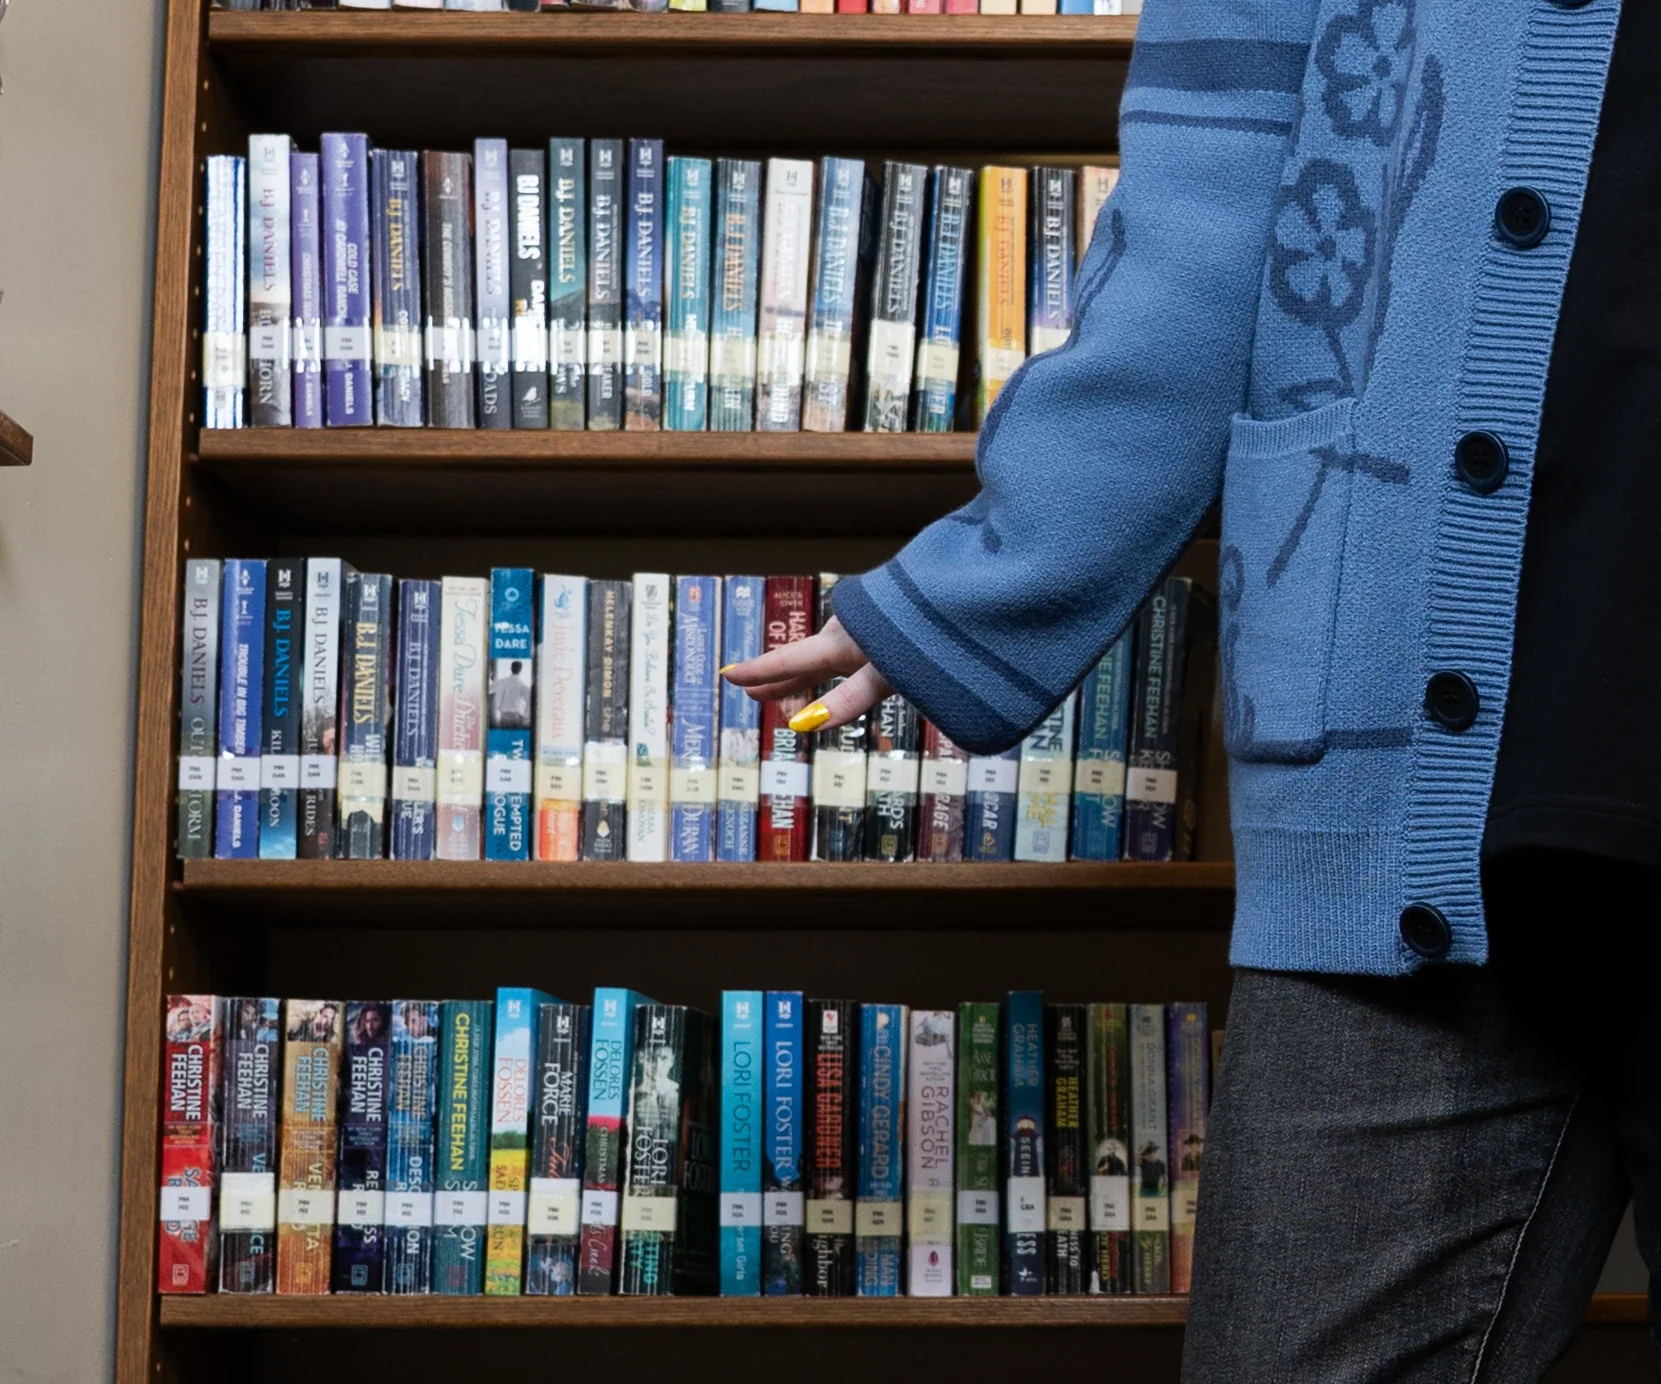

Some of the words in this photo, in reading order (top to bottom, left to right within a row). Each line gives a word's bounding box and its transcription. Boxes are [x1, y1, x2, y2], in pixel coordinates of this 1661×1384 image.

[347, 242, 358, 268] COLD
[348, 271, 358, 293] CASE
[637, 221, 652, 297] DANIELS
[1047, 243, 1062, 319] DANIELS
[453, 598, 478, 645] Tessa
[552, 623, 574, 662] Jude
[604, 591, 615, 653] HELENKAY
[1147, 596, 1166, 674] CHRISTINE
[189, 627, 207, 704] DANIELS
[237, 643, 249, 685] TROUBLE
[237, 687, 248, 697] IN
[313, 633, 328, 704] DANIELS
[453, 652, 477, 693] Dare
[602, 658, 613, 698] DIMON
[236, 698, 247, 716] BIG
[552, 666, 572, 740] Deveraux
[1143, 678, 1162, 739] FEEHAN
[235, 718, 247, 755] TIMBER
[305, 795, 316, 836] RIDES
[170, 1053, 187, 1111] FEEHAN
[186, 1044, 203, 1120] CHRISTINE
[351, 1056, 368, 1112] FEEHAN
[366, 1047, 383, 1122] CHRISTINE
[452, 1013, 469, 1099] CHRISTINE
[733, 1041, 752, 1087] LORI
[816, 1053, 842, 1088] LISA
[872, 1046, 892, 1099] CINDY
[497, 1057, 513, 1123] FOSSEN
[513, 1058, 527, 1122] DELORES
[542, 1063, 560, 1126] FORCE
[559, 1071, 573, 1116] MARIE
[1056, 1077, 1067, 1128] GRAHAM
[1067, 1077, 1078, 1128] HEATHER
[450, 1103, 465, 1170] FEEHAN
[597, 1127, 609, 1184] CHRISTMAS
[733, 1093, 751, 1172] FOSTER
[816, 1093, 843, 1167] GARDNER
[871, 1106, 891, 1178] GERARD
[920, 1086, 935, 1169] GIBSON
[934, 1086, 949, 1168] RACHEL
[736, 1256, 746, 1280] Girls
